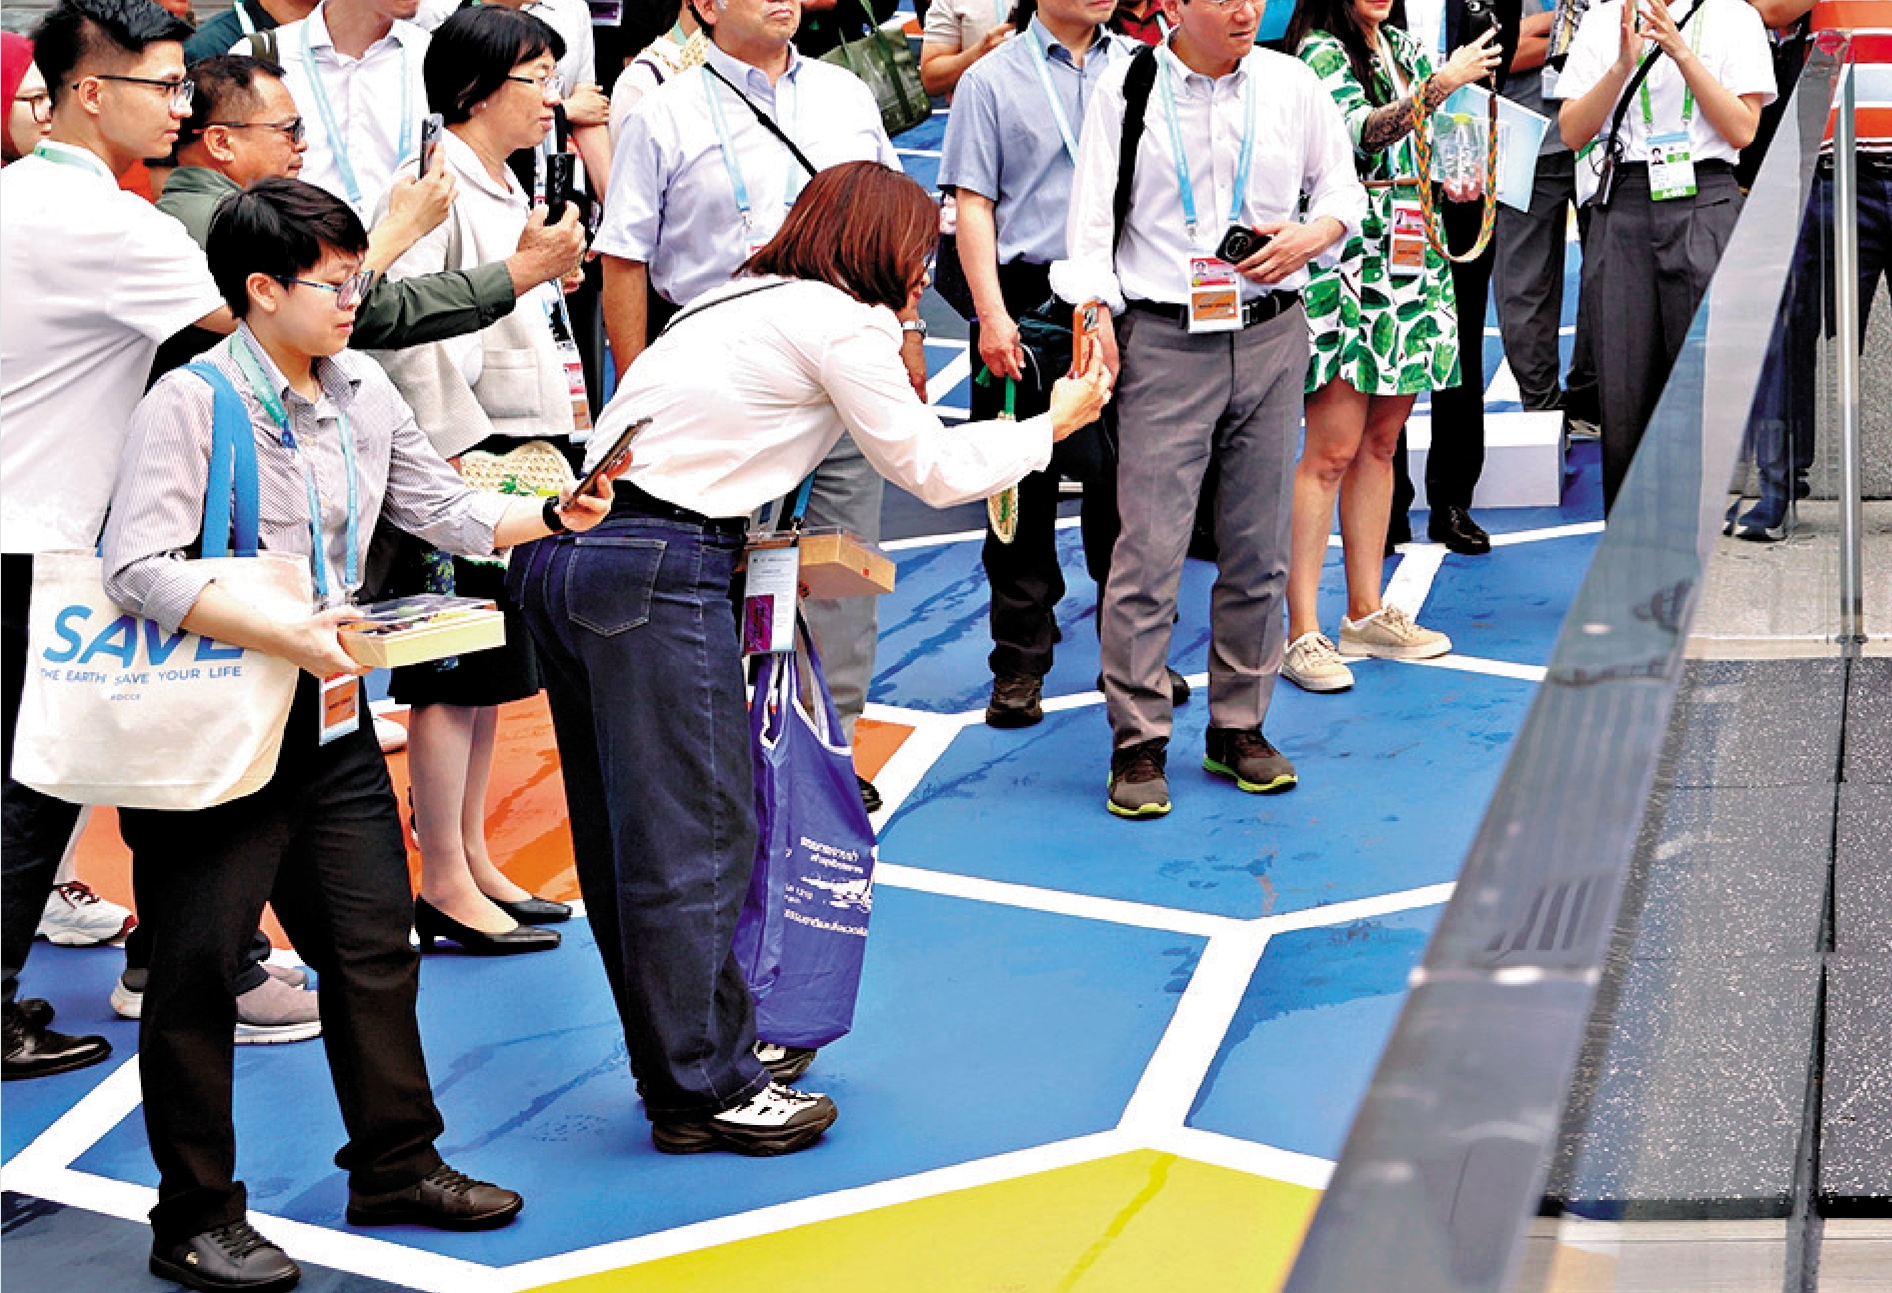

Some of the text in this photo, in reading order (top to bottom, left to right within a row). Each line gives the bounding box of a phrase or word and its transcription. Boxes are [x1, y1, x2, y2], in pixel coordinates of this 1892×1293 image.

[65, 670, 108, 685] EARTH
[114, 673, 150, 687] SAVE
[158, 667, 200, 682] YOUR
[208, 665, 243, 679] LIFE
